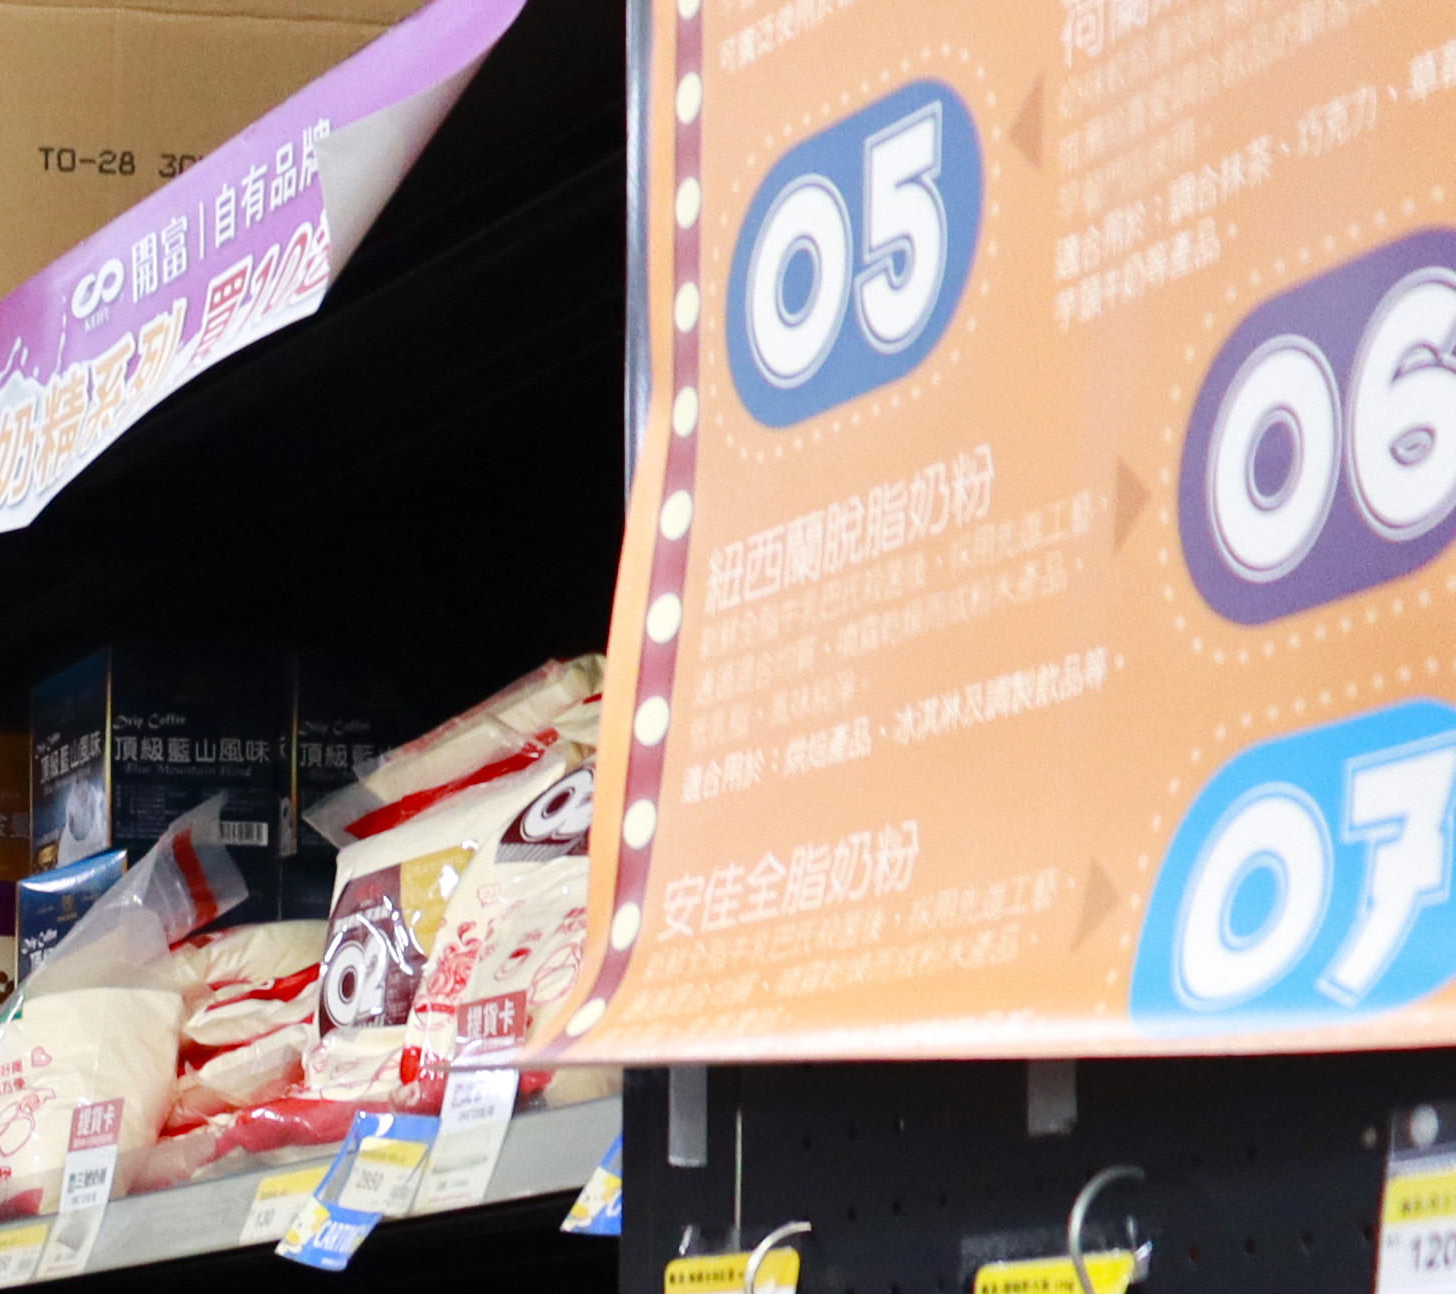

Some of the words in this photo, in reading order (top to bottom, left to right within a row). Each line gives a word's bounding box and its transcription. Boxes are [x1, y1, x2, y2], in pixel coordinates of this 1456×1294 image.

[38, 146, 136, 176] TO-28
[133, 216, 188, 303] 開富
[214, 117, 331, 248] 自有品牌
[747, 97, 950, 390] 05
[1207, 265, 1456, 583] 06
[704, 442, 995, 614] 紐西蘭脫脂奶粉
[114, 736, 269, 763] 頂級藍山風味
[658, 819, 919, 942] 安佳全脂奶粉
[1171, 729, 1456, 1013] 07
[77, 1104, 115, 1135] 提貨卡
